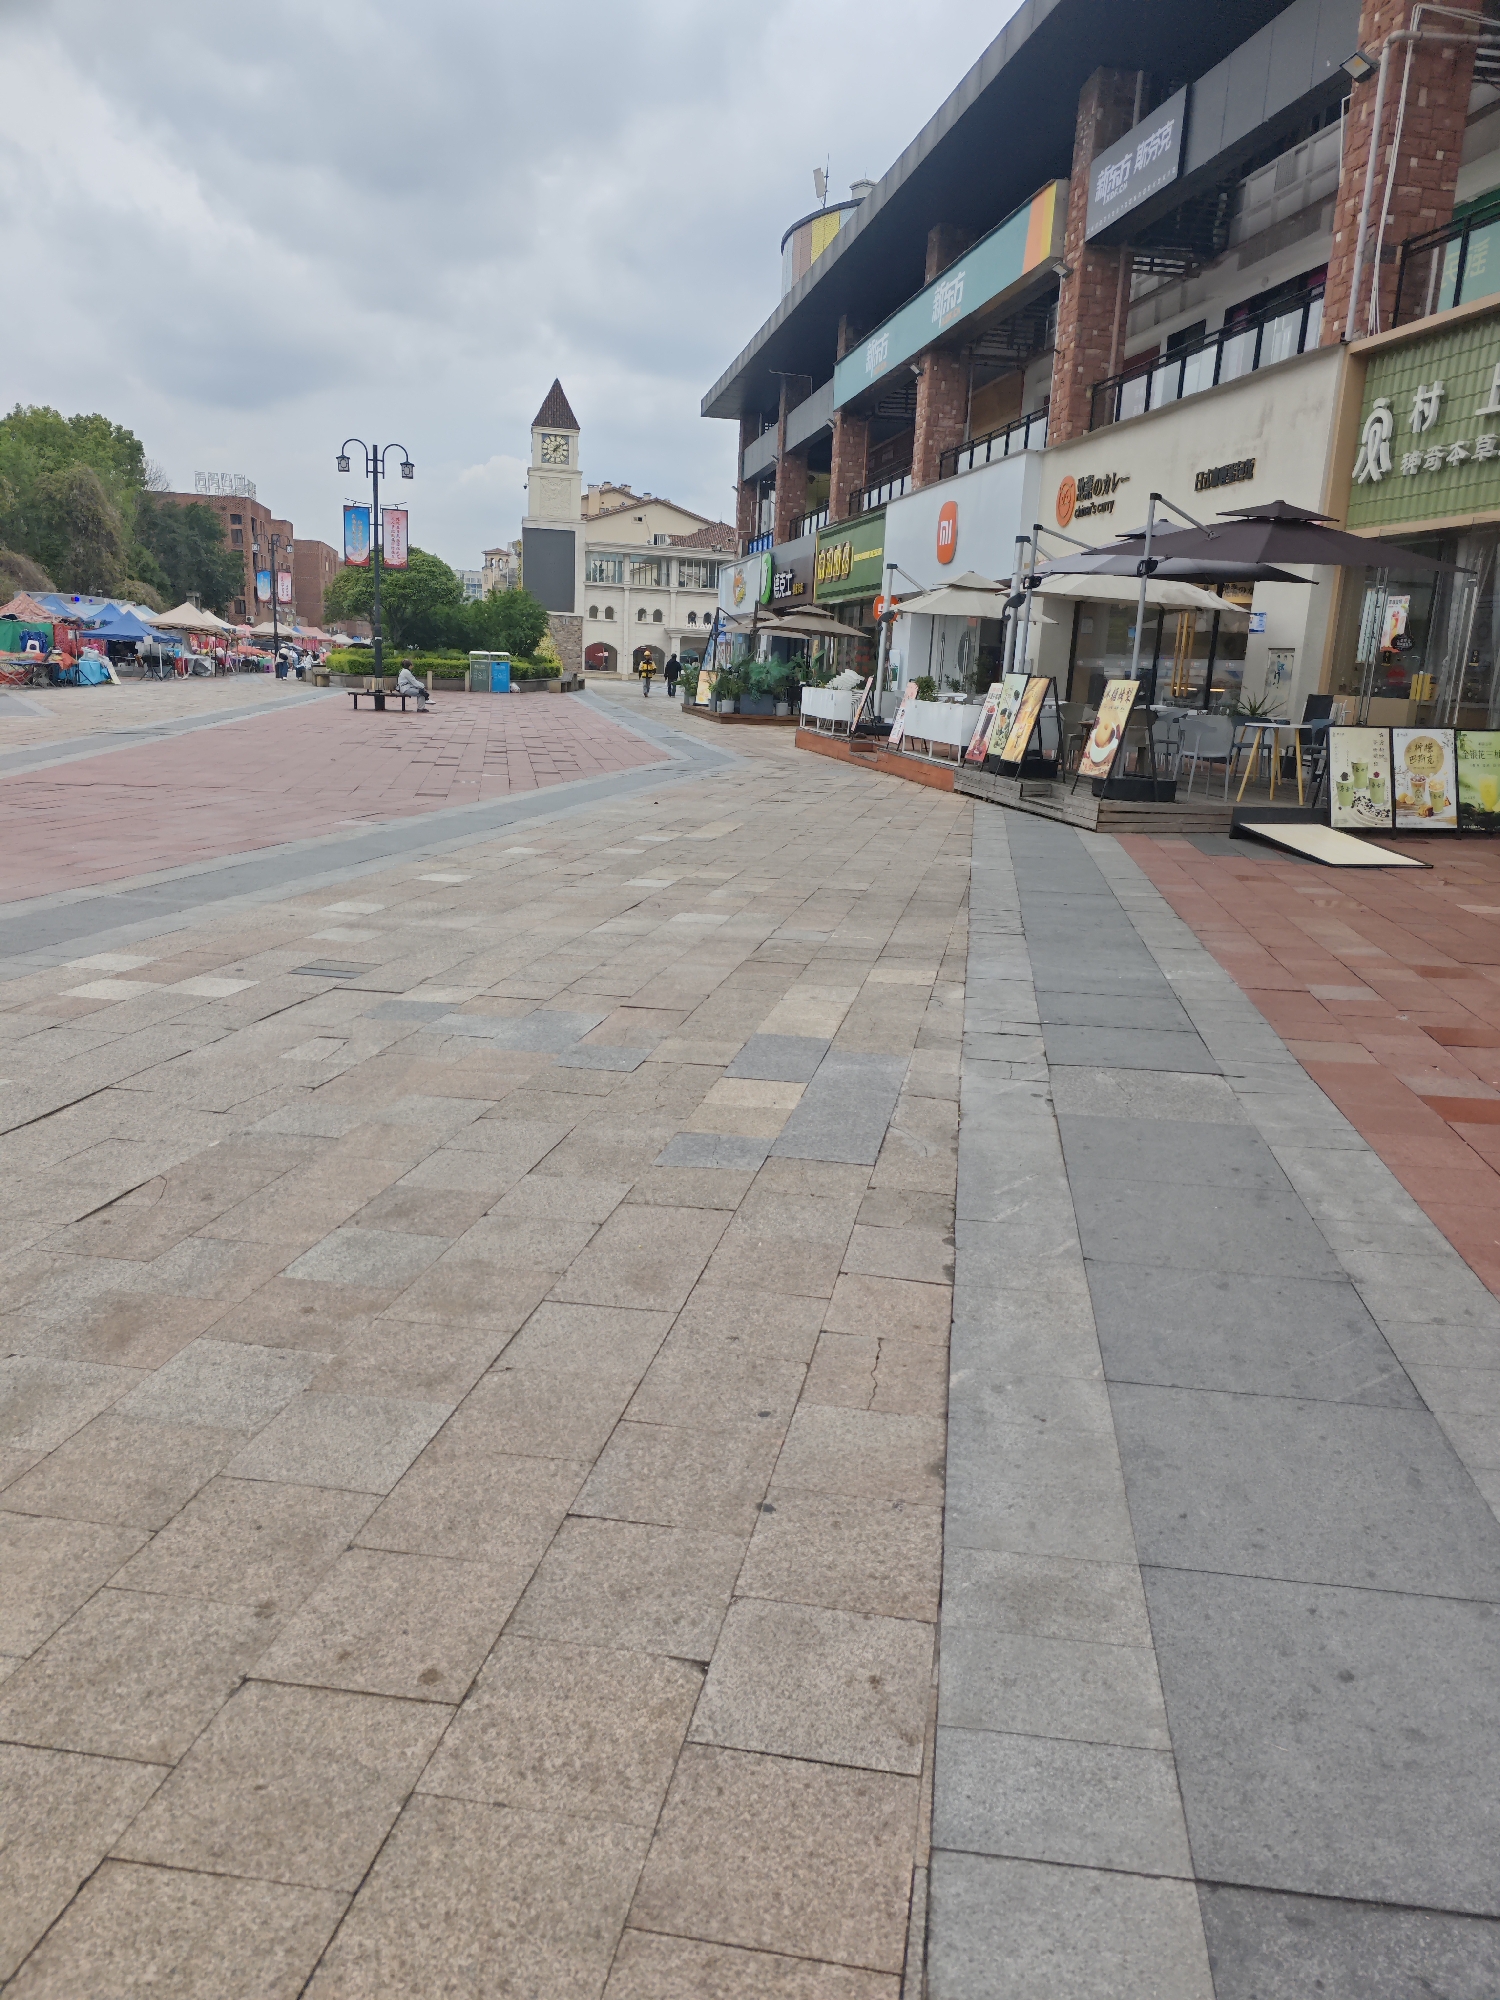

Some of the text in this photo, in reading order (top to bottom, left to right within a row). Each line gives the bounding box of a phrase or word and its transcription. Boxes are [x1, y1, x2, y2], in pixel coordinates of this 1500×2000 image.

[1095, 153, 1133, 206] 新东方
[1133, 119, 1175, 175] 斯芬克
[931, 270, 966, 329] 新东方
[865, 333, 889, 378] 新东方
[1400, 433, 1500, 475] 神奇本草
[773, 568, 793, 600] 德克士
[686, 622, 712, 630] HUAW
